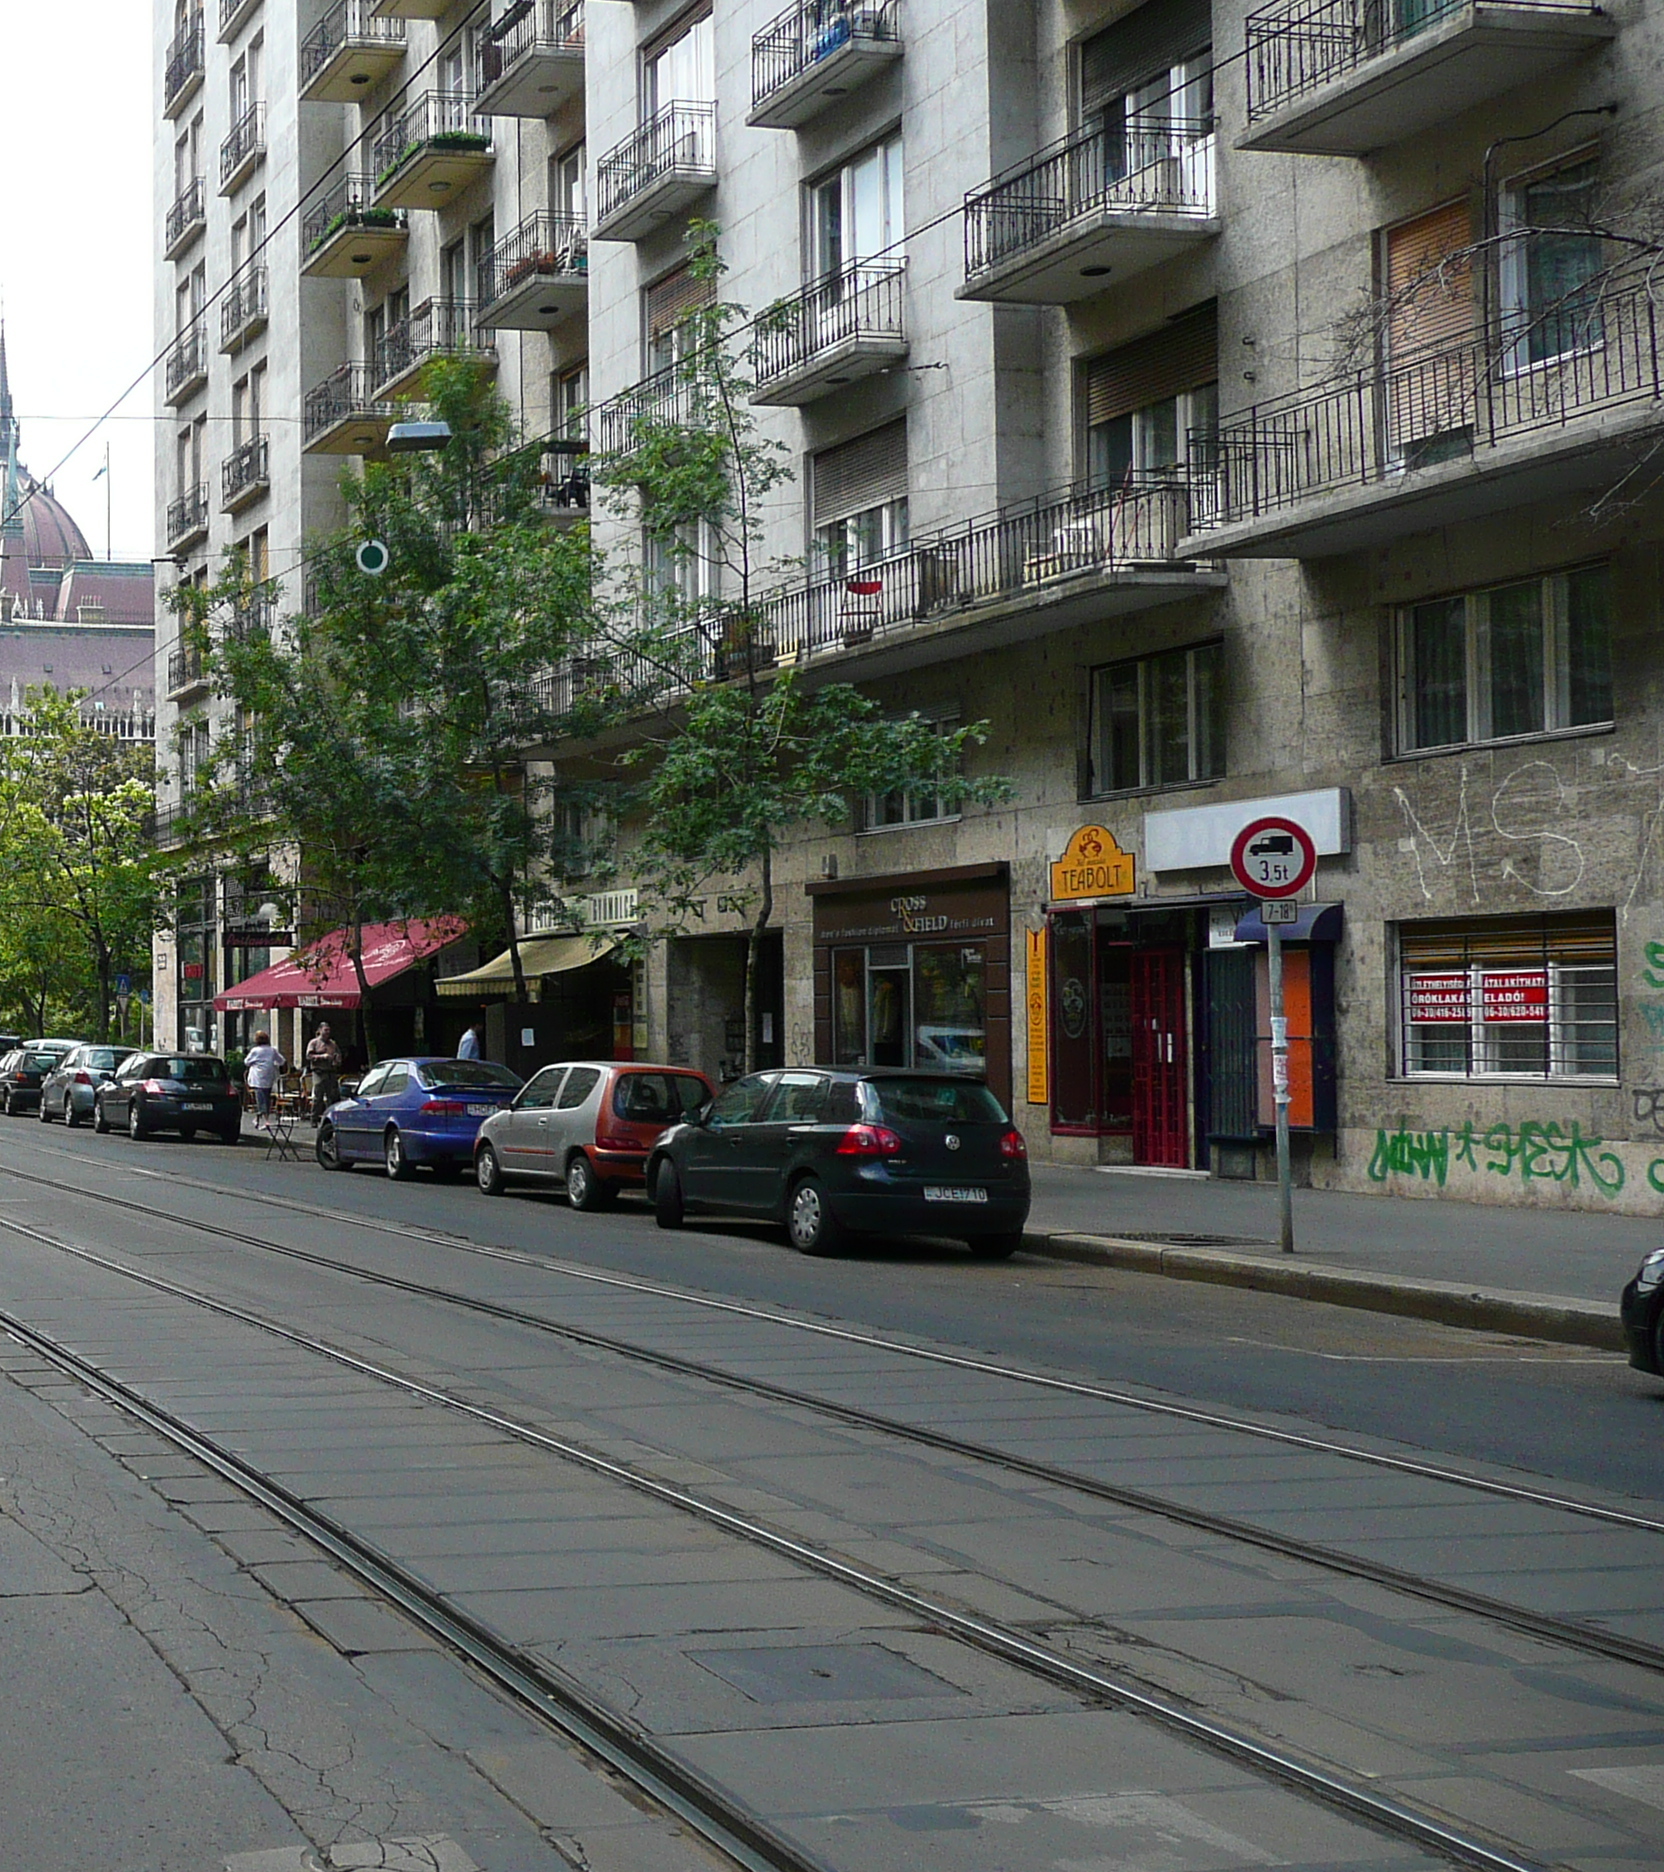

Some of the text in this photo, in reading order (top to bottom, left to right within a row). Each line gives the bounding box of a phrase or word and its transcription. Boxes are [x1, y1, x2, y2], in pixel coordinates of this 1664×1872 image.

[1061, 864, 1122, 893] TEABOLT
[890, 896, 927, 918] CROSS
[1484, 990, 1525, 1003] ELADÓ!
